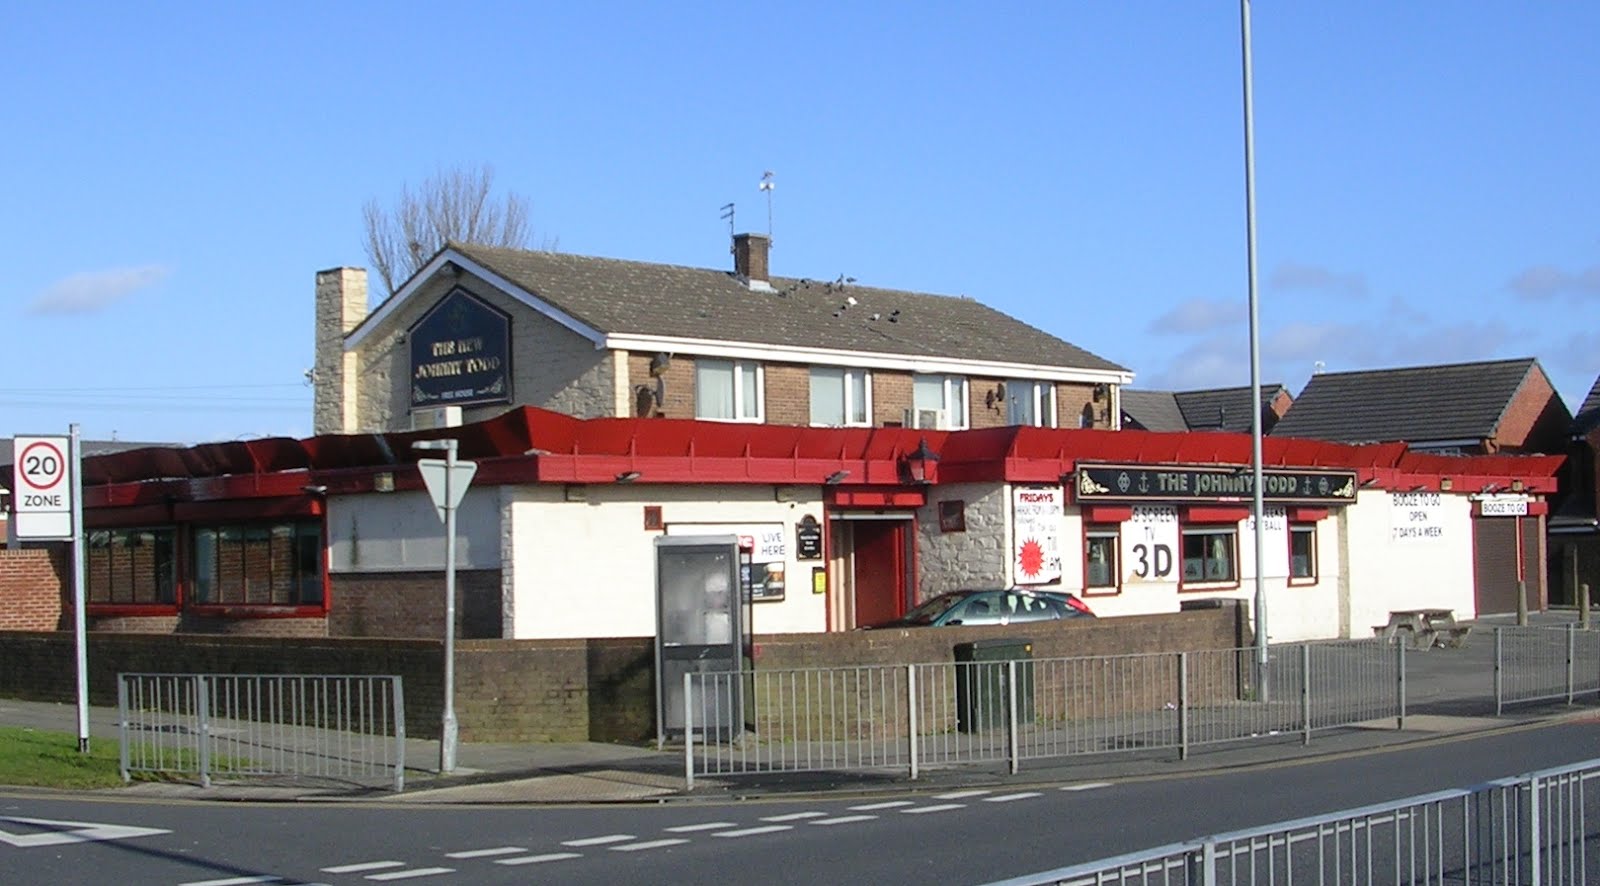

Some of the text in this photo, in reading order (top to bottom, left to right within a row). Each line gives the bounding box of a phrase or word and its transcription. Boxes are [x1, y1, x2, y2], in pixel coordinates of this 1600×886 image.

[465, 356, 501, 373] TODD
[26, 456, 57, 475] 20
[1157, 473, 1297, 497] THE JOHNNY TODD
[24, 495, 61, 506] ZONE
[1019, 493, 1054, 503] FRIDAYS
[1393, 493, 1441, 506] BOOZE TO GO
[1483, 503, 1526, 513] BOOZE TO GO
[1142, 506, 1178, 522] SCREEN
[1409, 511, 1427, 522] OPEN
[1245, 520, 1282, 531] FOBALL
[762, 532, 782, 543] LIVE
[1144, 526, 1156, 542] TV
[1399, 527, 1417, 538] DAYS
[1418, 527, 1423, 537] A
[1424, 527, 1442, 537] WEEK
[761, 545, 785, 556] HERE
[1132, 543, 1173, 578] 3D
